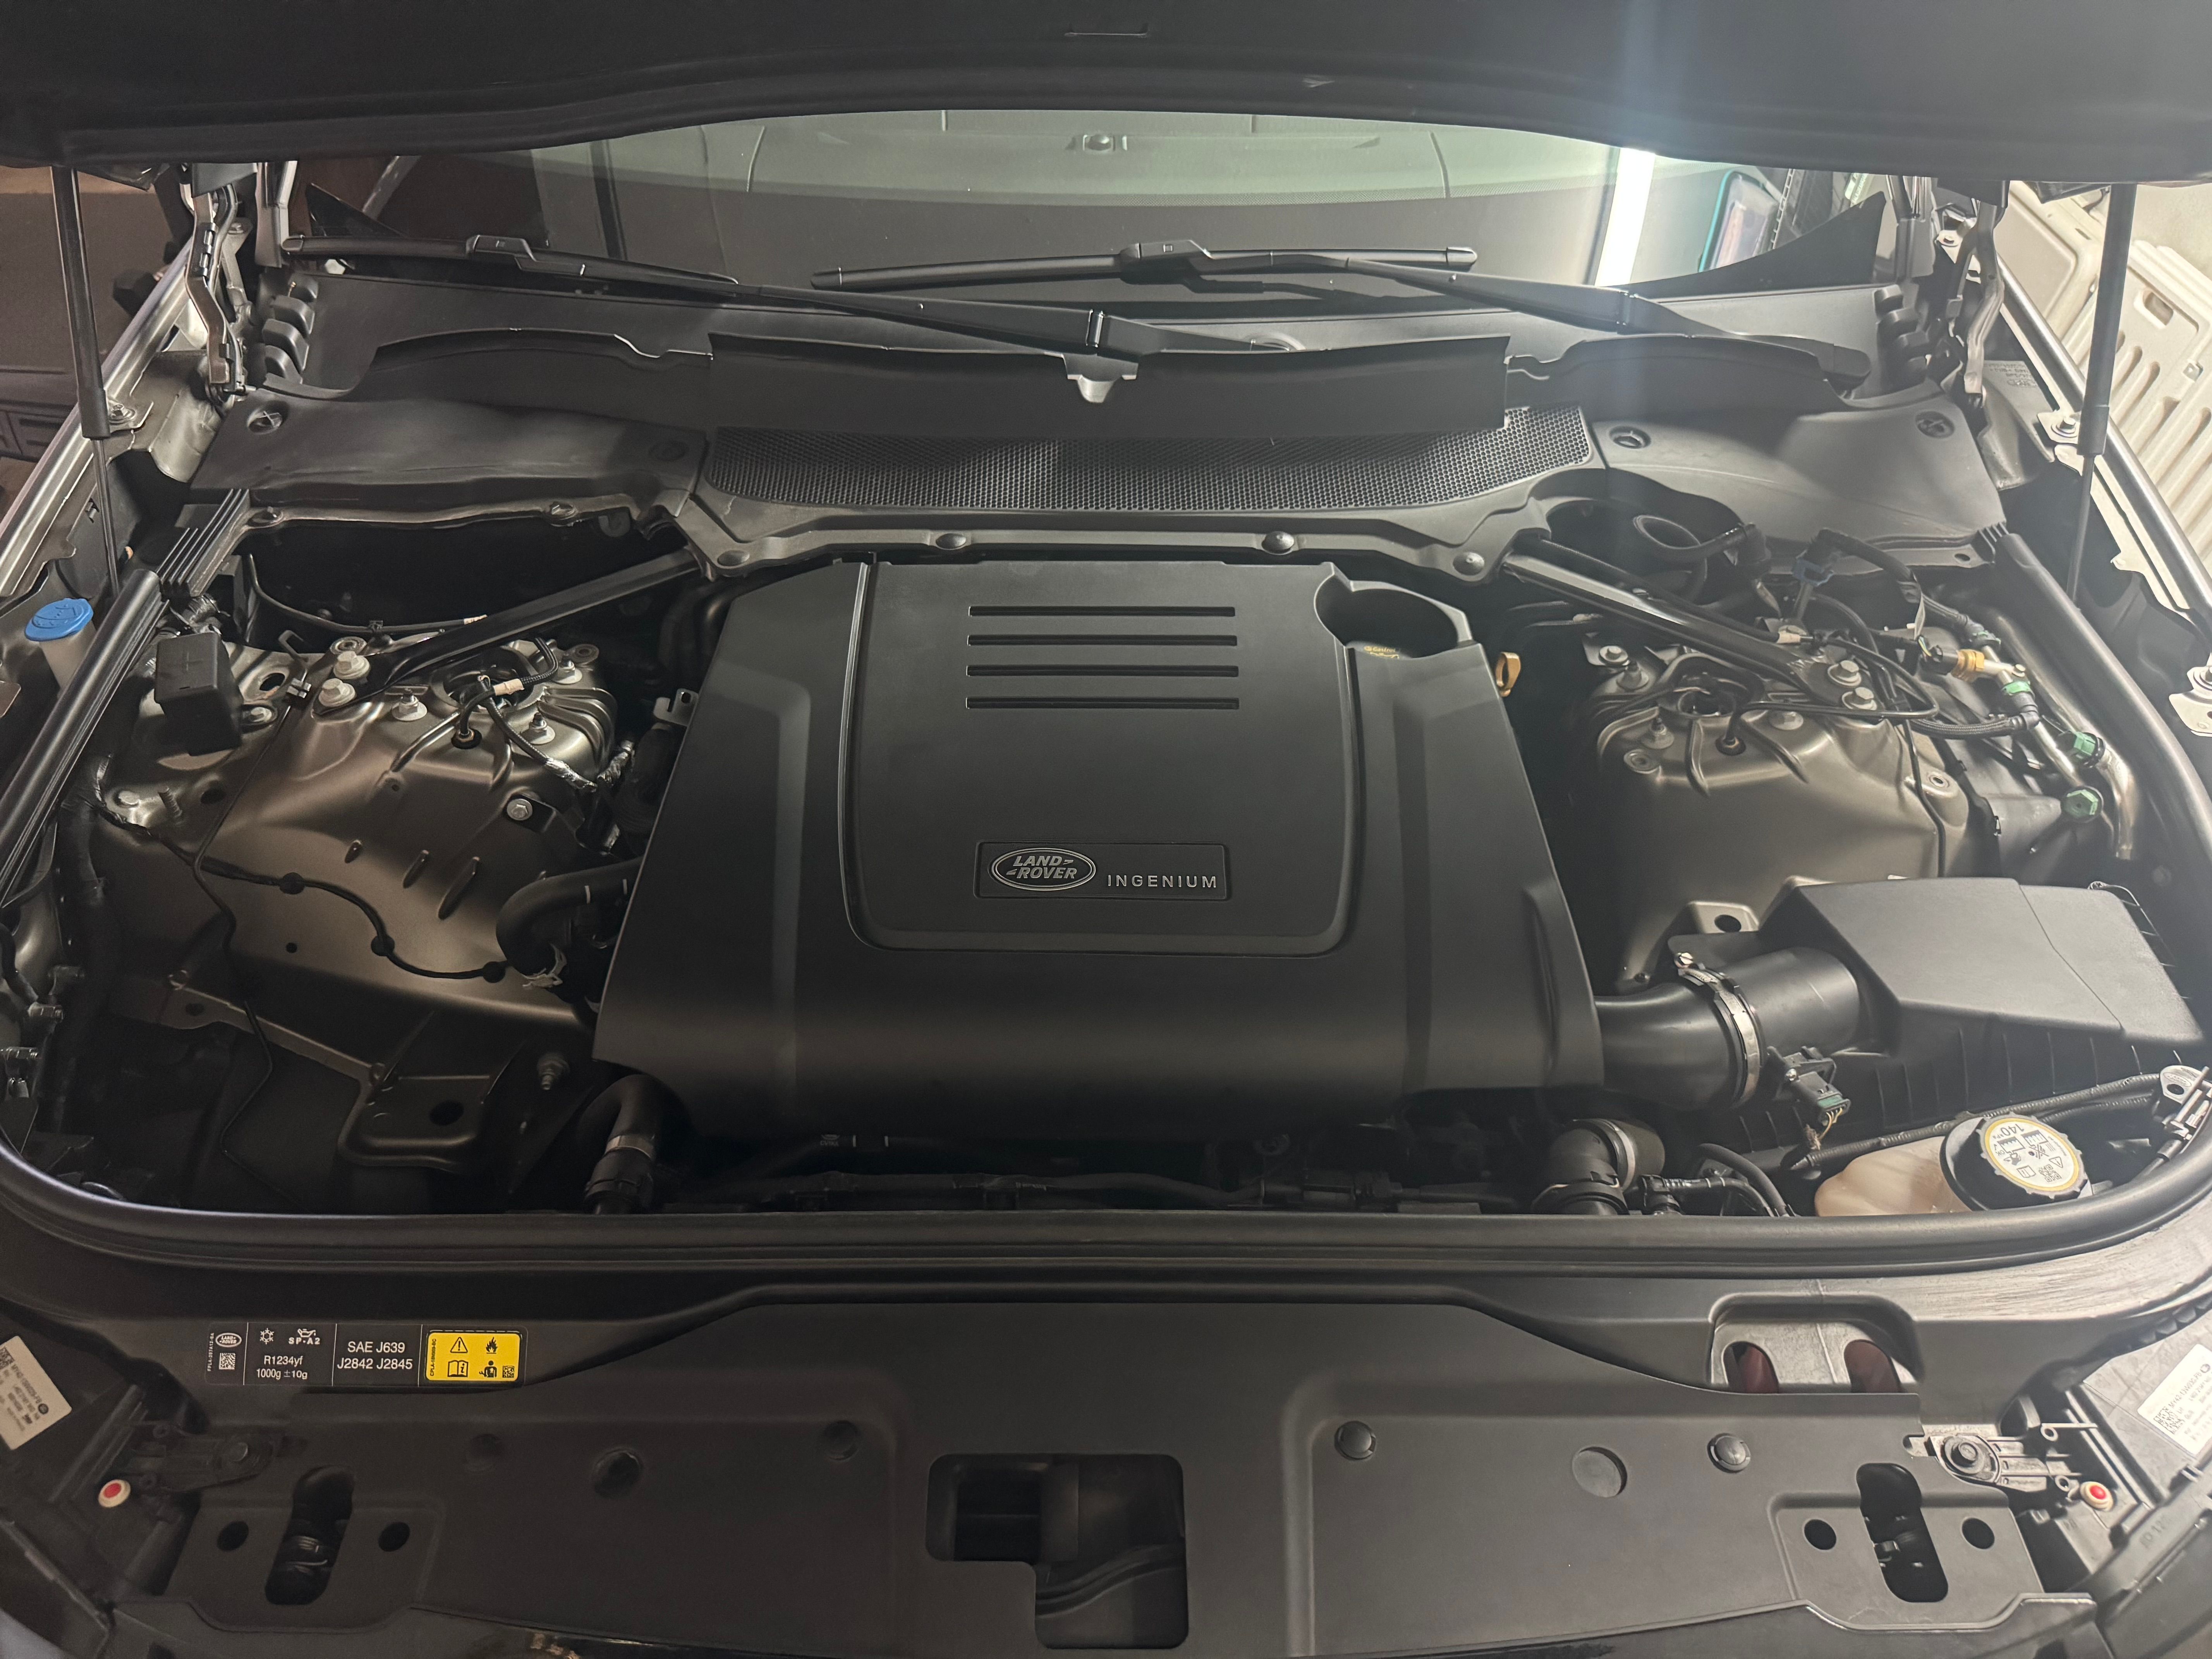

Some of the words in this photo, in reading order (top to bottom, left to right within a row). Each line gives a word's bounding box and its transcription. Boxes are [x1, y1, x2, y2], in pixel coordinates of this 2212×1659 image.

[1013, 856, 1062, 866] LAND
[1017, 867, 1077, 879] ROVER
[1107, 874, 1216, 888] INGENIUM
[2001, 1123, 2025, 1136] 140
[347, 1341, 373, 1353] SAE
[376, 1342, 405, 1353] J639
[264, 1355, 303, 1367] R1234yf
[337, 1358, 373, 1369] J2842
[376, 1358, 413, 1370] J2845
[256, 1369, 281, 1380] 1000g
[284, 1370, 308, 1380] ±10g
